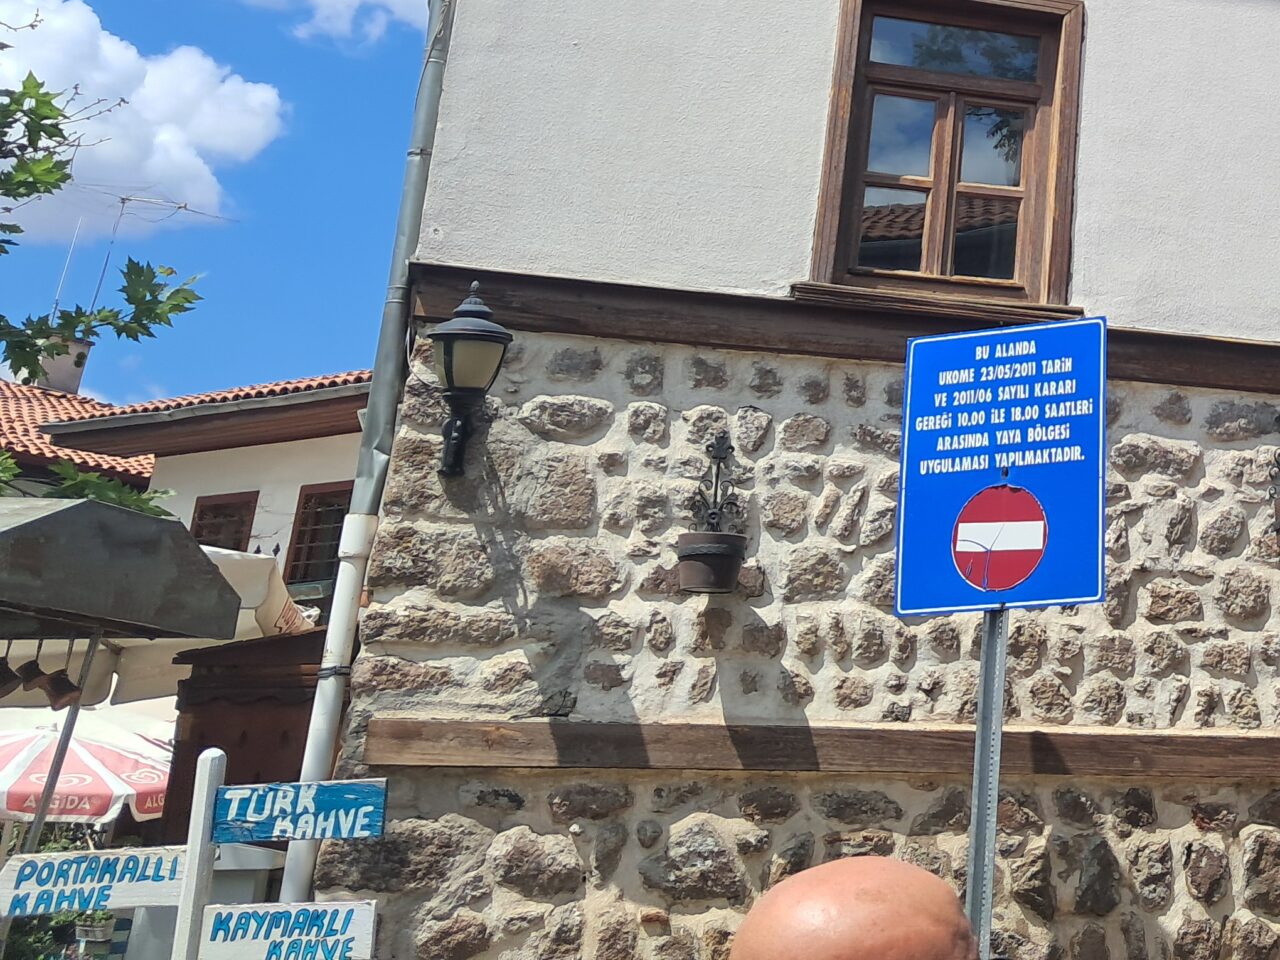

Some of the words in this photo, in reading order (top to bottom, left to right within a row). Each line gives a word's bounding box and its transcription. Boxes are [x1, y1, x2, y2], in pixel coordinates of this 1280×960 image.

[975, 345, 990, 360] BU
[995, 340, 1036, 358] ALANDA
[939, 368, 975, 385] UKOME
[980, 361, 1036, 381] 23/05/2011
[934, 393, 947, 407] VE
[953, 390, 992, 406] 2011/06
[998, 384, 1029, 401] SAYILI
[1034, 379, 1077, 397] KARARI
[957, 410, 985, 427] 10.00
[1011, 405, 1039, 422] 18.00
[936, 432, 989, 451] ARASINDA
[996, 428, 1021, 445] YAYA
[919, 454, 989, 475] UYGULAMASI
[995, 445, 1085, 468] YAPILMAKTADIR.
[224, 785, 318, 822] TÜRK
[272, 805, 375, 840] KAHVE
[14, 851, 178, 890] PORTAKALLI
[7, 884, 113, 917] KAHVE
[209, 907, 355, 943] KAYMAKLI
[264, 936, 356, 960] KAHVE
